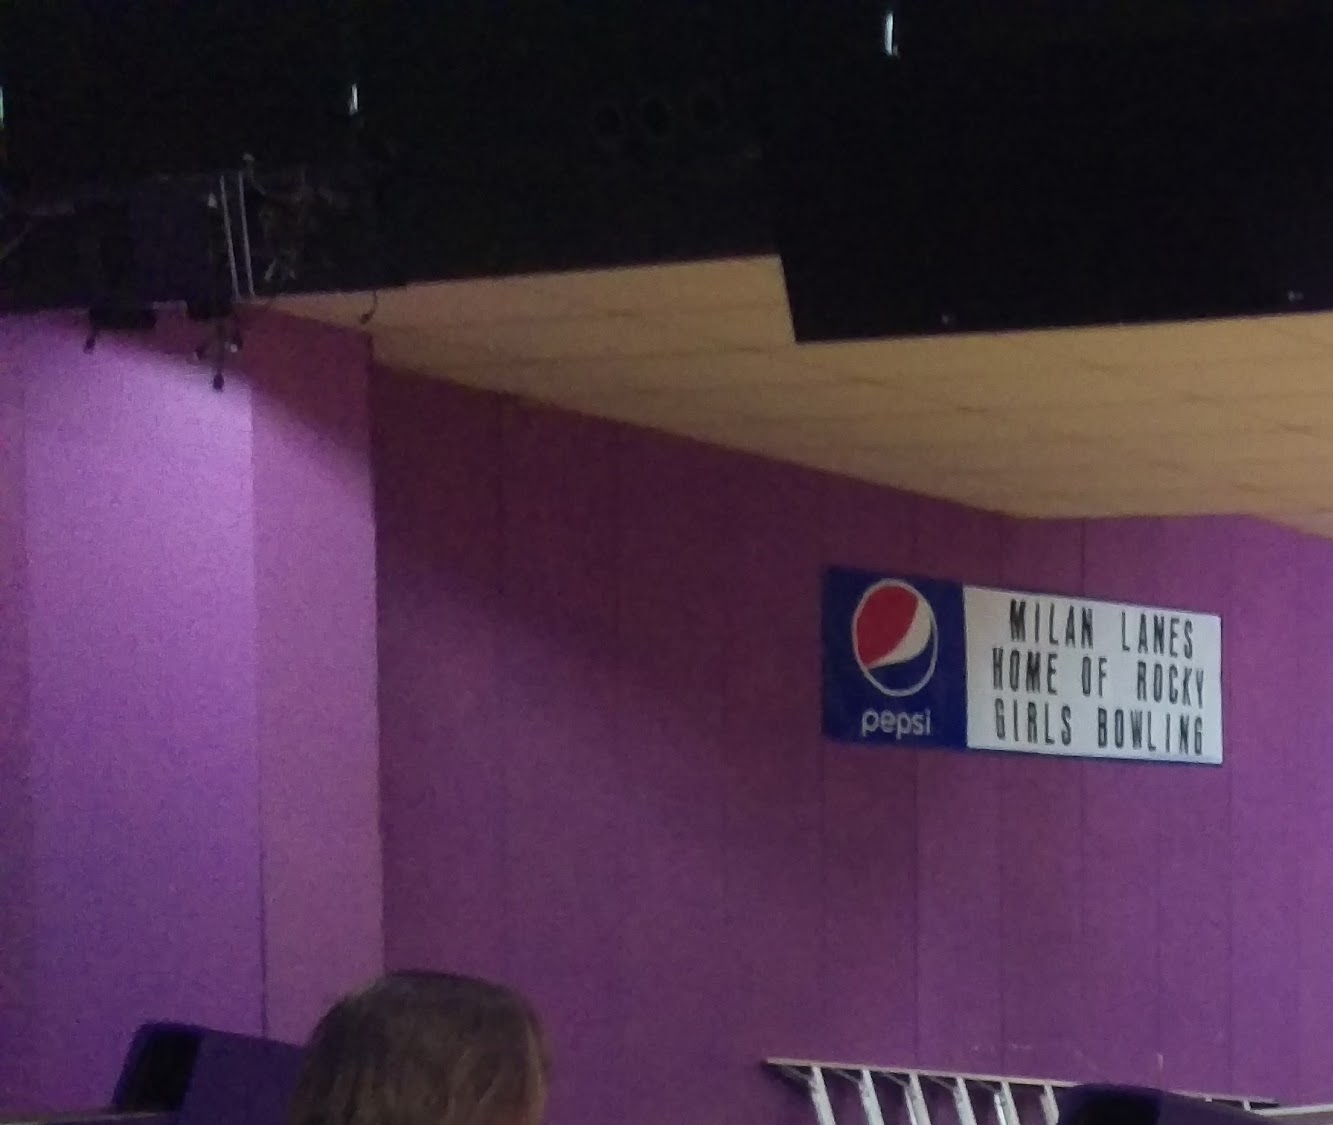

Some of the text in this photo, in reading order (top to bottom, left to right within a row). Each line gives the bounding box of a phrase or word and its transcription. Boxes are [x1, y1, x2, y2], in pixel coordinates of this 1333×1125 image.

[1010, 599, 1193, 660] MILAN LANES
[992, 647, 1205, 710] HOME OF ROCKY
[861, 709, 931, 740] pepsi
[994, 698, 1203, 756] GIRLS BOWLING
